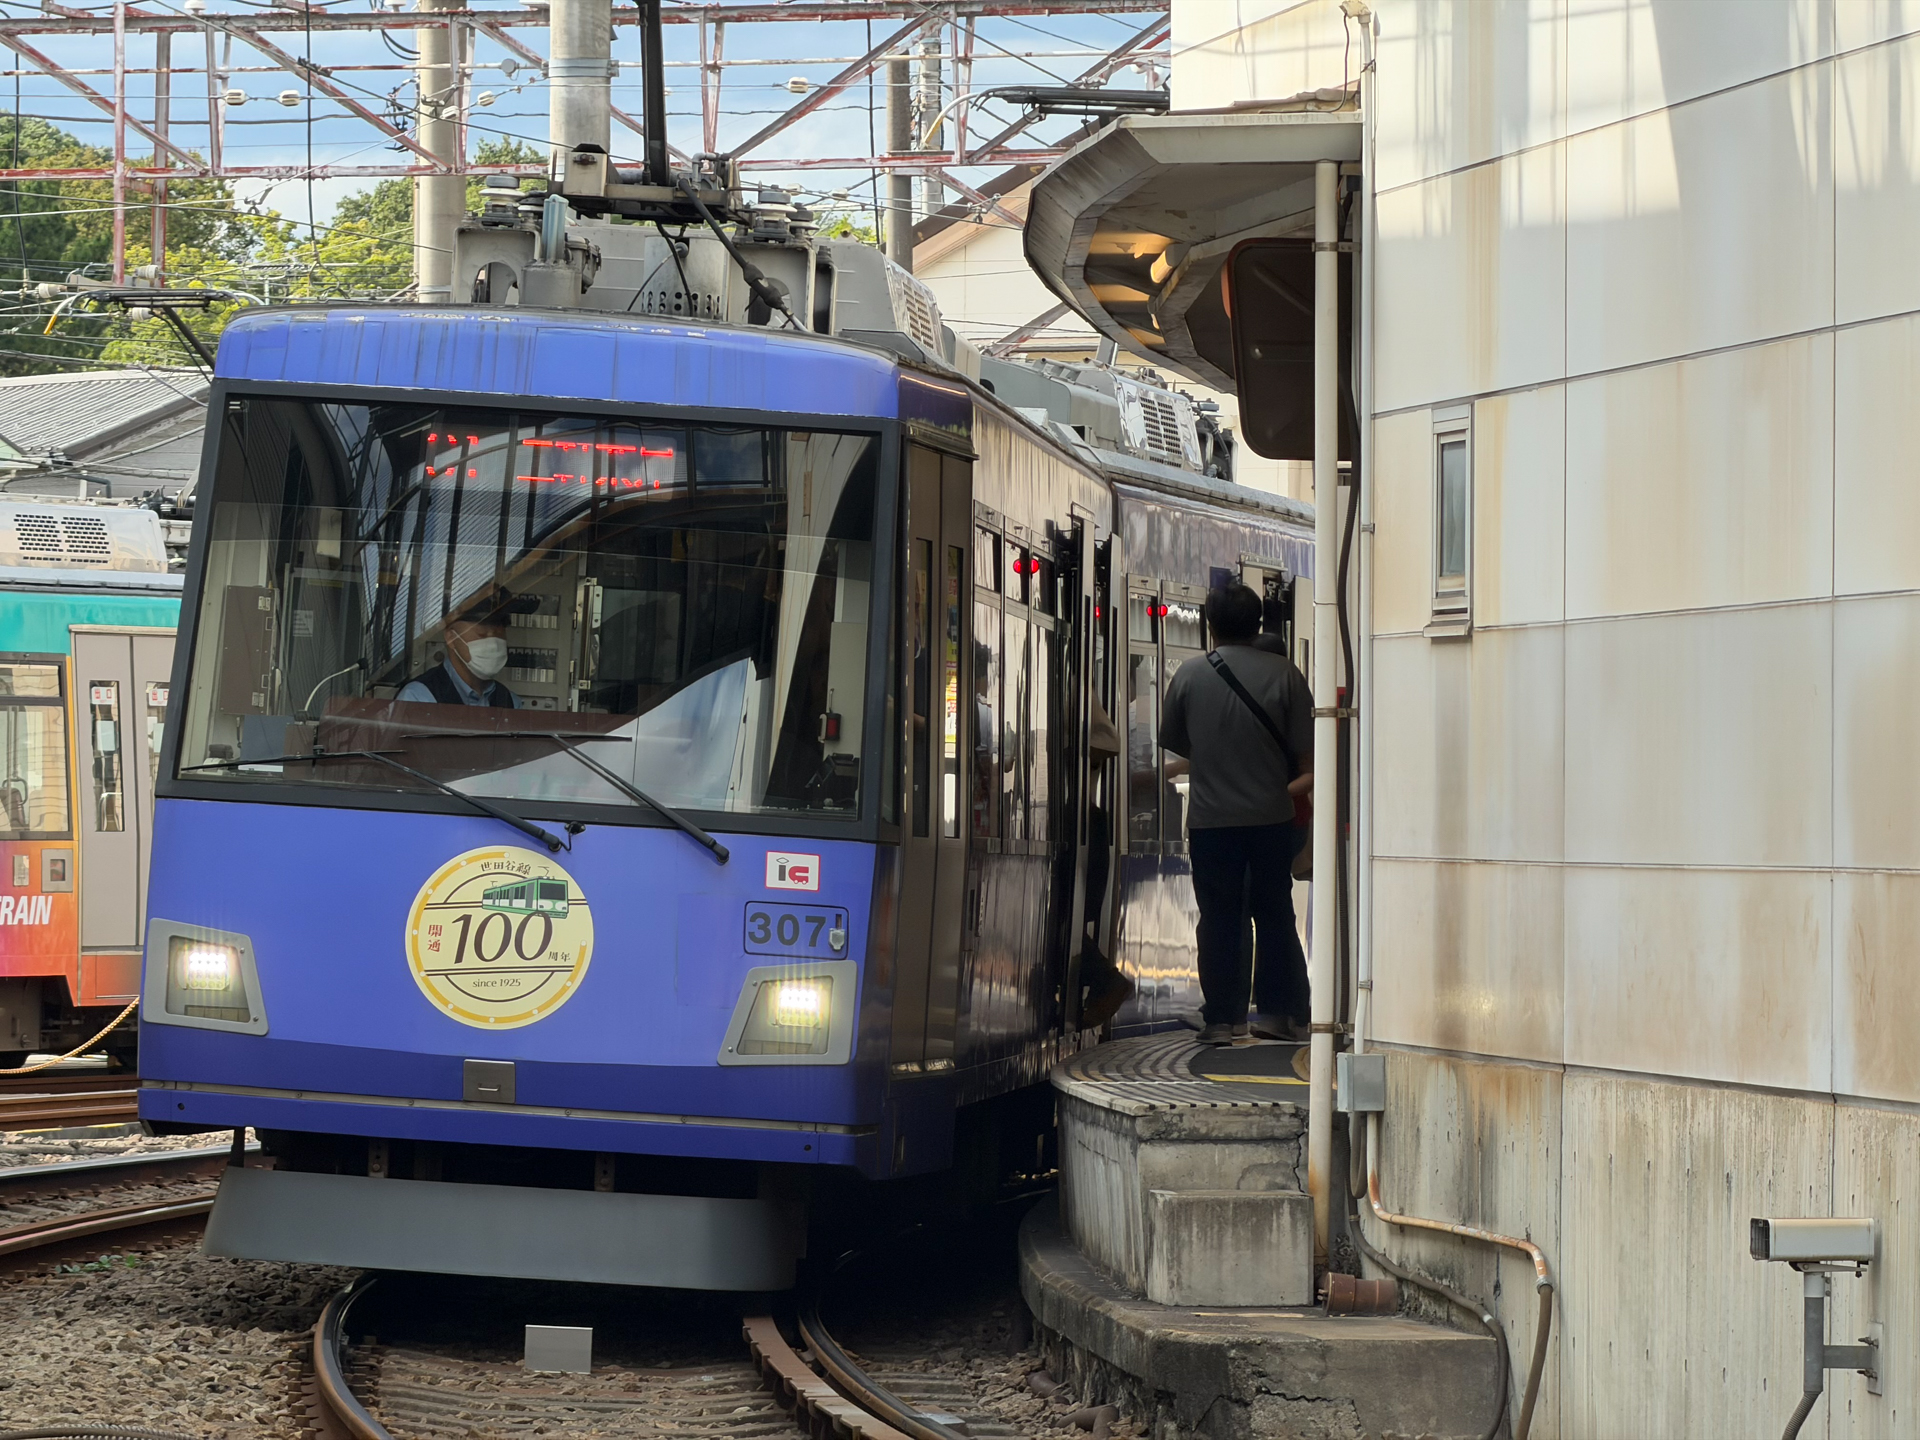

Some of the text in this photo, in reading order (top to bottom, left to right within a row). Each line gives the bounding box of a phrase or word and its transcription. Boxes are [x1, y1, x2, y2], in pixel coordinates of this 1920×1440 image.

[480, 860, 532, 876] 世田谷線
[0, 895, 53, 925] RAIN
[427, 923, 443, 953] 開通
[748, 911, 827, 948] 307
[472, 978, 521, 988] since 1925
